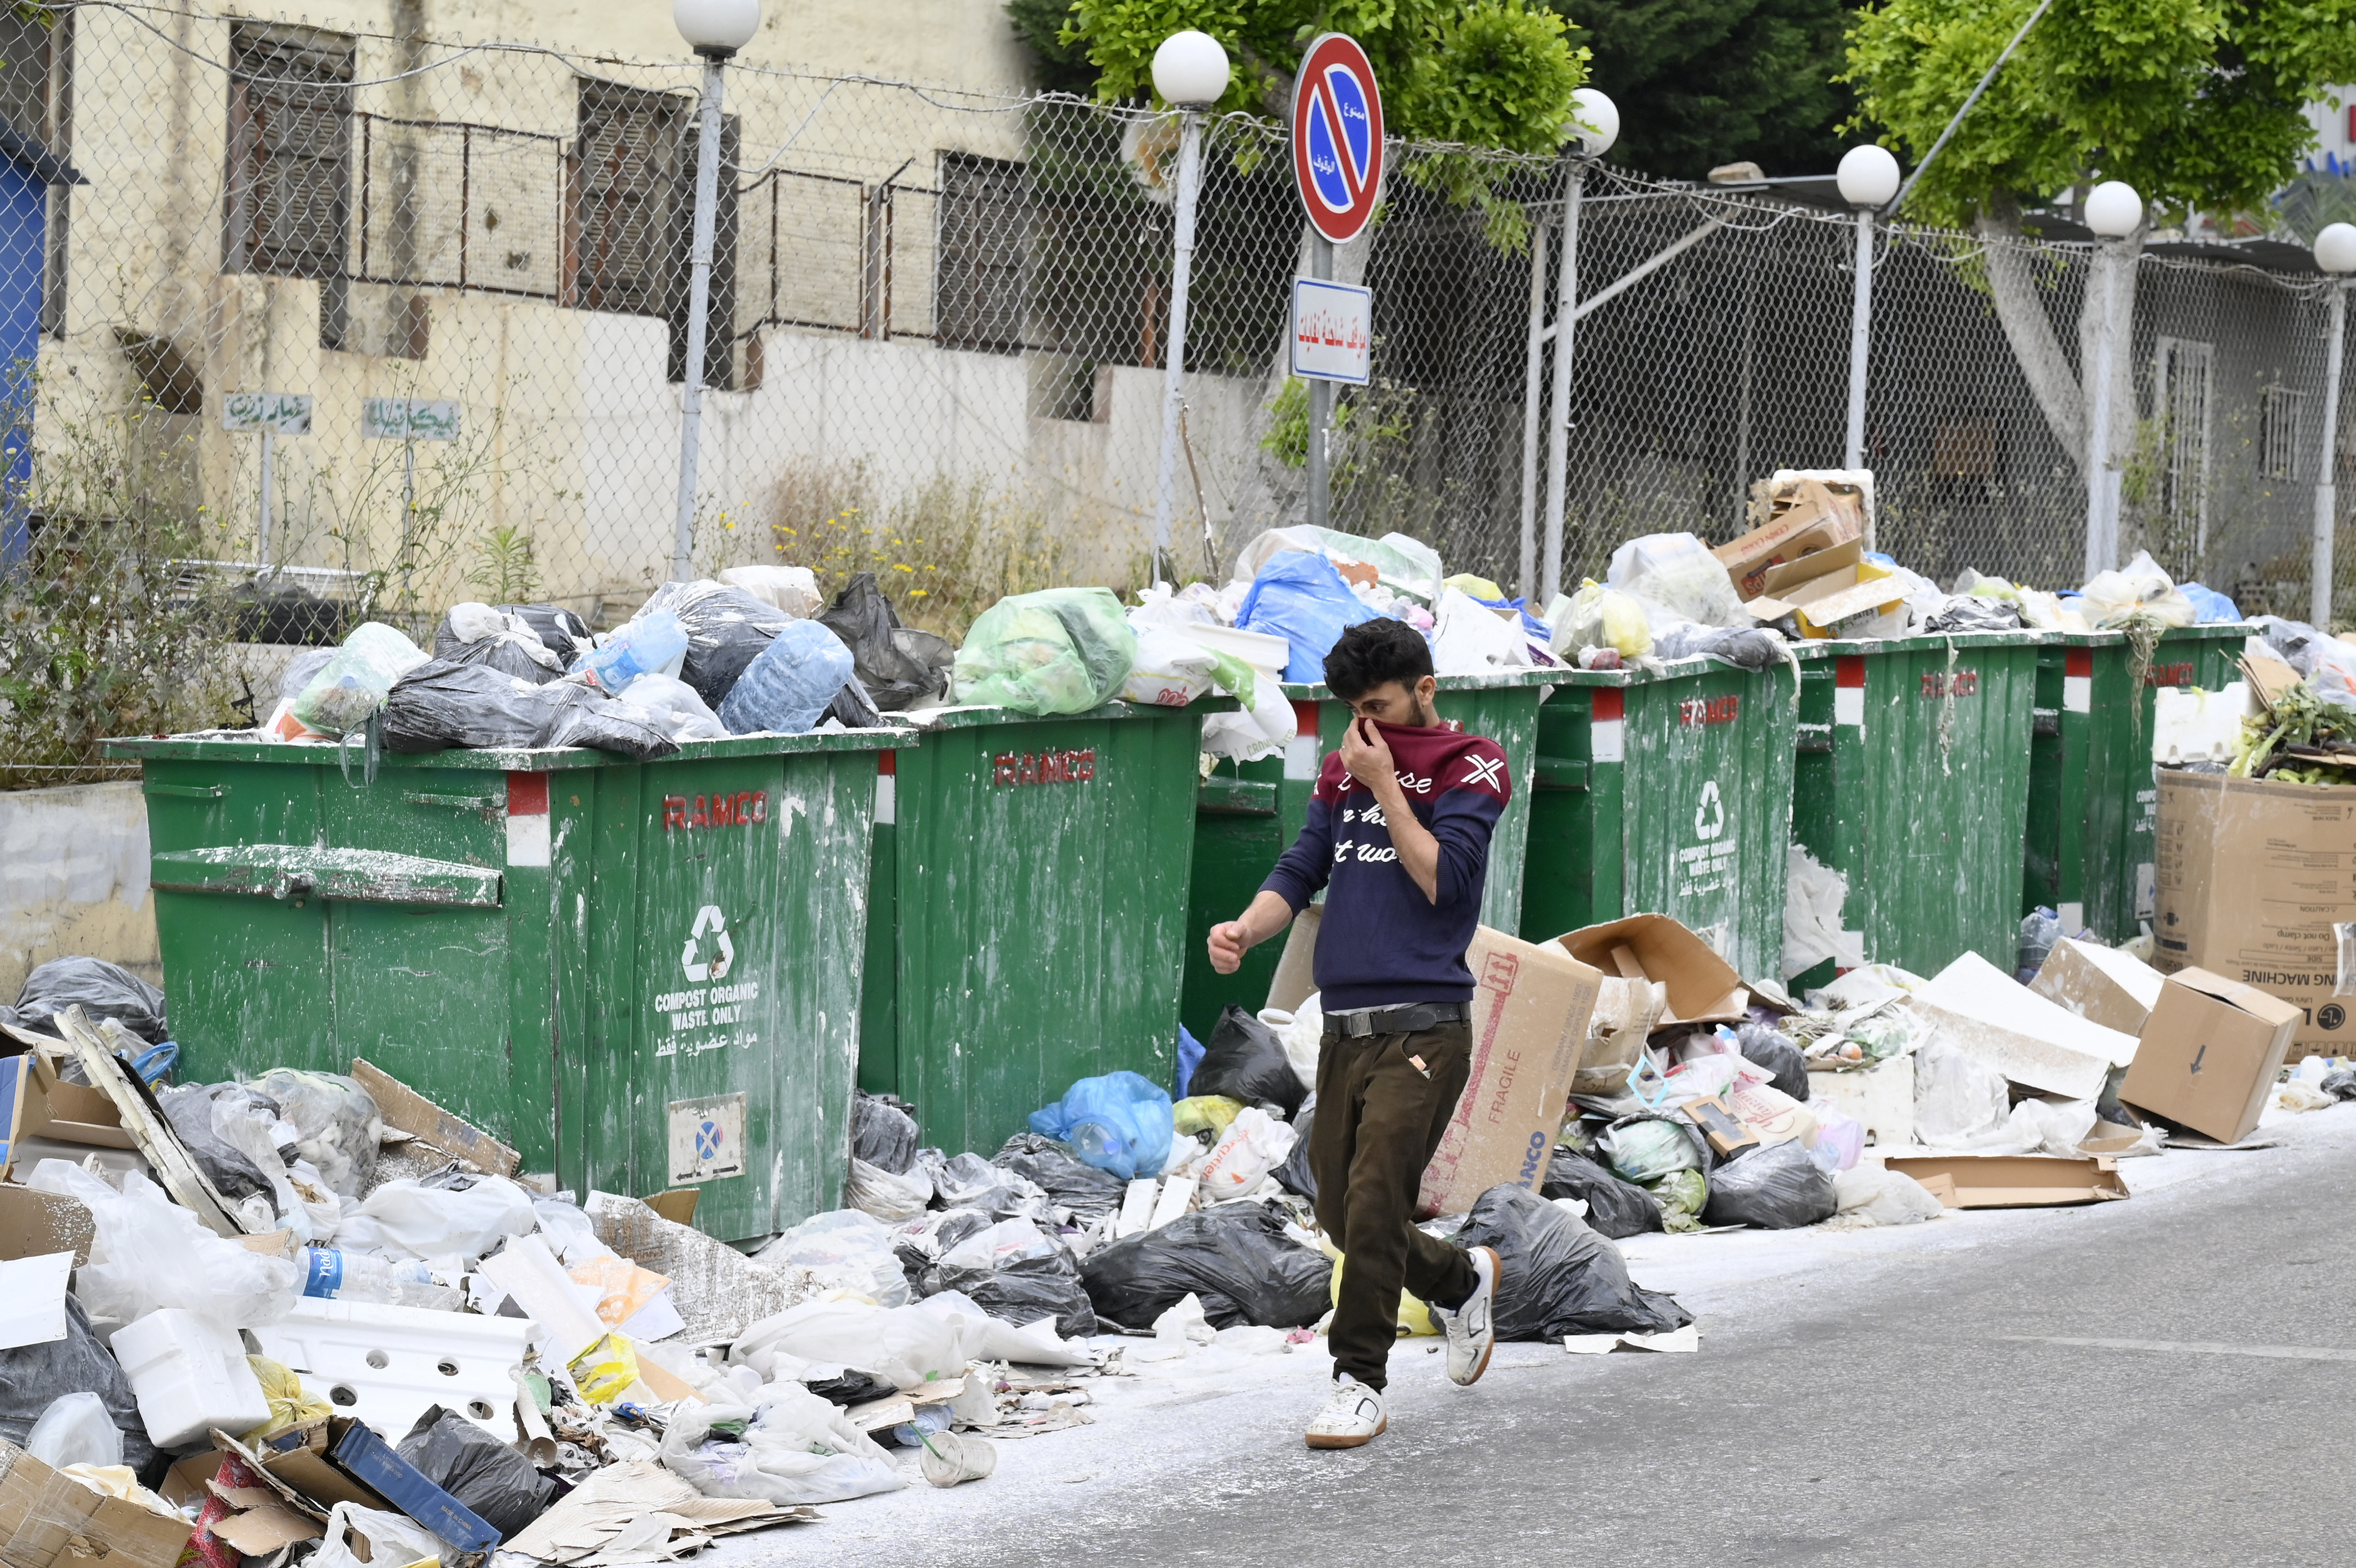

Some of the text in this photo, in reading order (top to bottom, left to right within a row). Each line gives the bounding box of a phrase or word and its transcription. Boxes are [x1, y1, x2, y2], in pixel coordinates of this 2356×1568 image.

[1343, 101, 1365, 121] ممنوع
[1313, 154, 1335, 175] الوقوف
[1680, 696, 1738, 727] RAMCO
[994, 749, 1095, 785] RAMCO
[662, 790, 768, 830] RAMCO
[1679, 844, 1710, 863] COMPOST
[1689, 856, 1727, 877] WASTE ONLY
[2277, 930, 2301, 941] clamp
[2319, 933, 2330, 941] Do
[2242, 970, 2310, 986] MACHINE
[655, 981, 758, 1013] COMPOST ORGANIC
[672, 1004, 742, 1031] WASTE ONLY
[655, 1028, 758, 1057] مواد عضوية فقط
[1488, 1049, 1521, 1125] FRAGILE
[383, 1453, 404, 1470] Lebanon
[440, 1505, 454, 1518] MADE
[457, 1517, 472, 1532] CHINA
